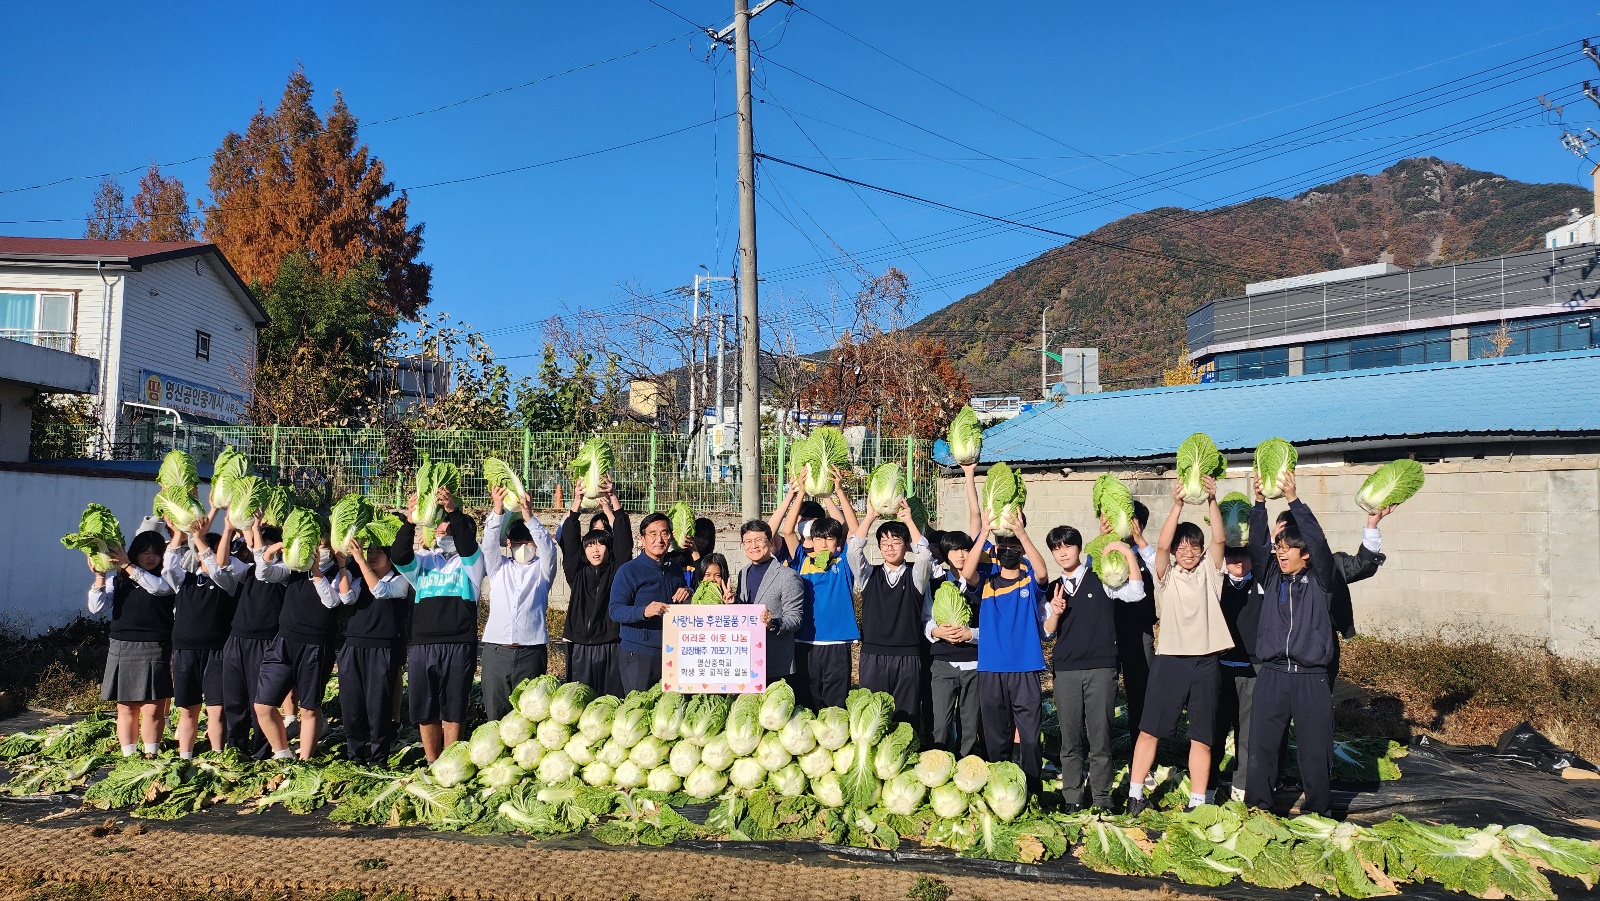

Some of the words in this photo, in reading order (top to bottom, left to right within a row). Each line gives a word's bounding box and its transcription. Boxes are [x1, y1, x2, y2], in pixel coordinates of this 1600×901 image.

[148, 379, 161, 401] 땅
[165, 380, 224, 412] 영신공인중개사
[672, 615, 704, 628] 사랑나눔
[706, 614, 739, 628] 후원물품
[741, 615, 758, 627] 기탁
[681, 633, 706, 643] 어려운
[710, 633, 727, 643] 이웃
[731, 633, 748, 643] 나눔
[697, 658, 732, 668] 영신중학교
[681, 668, 695, 677] 학생
